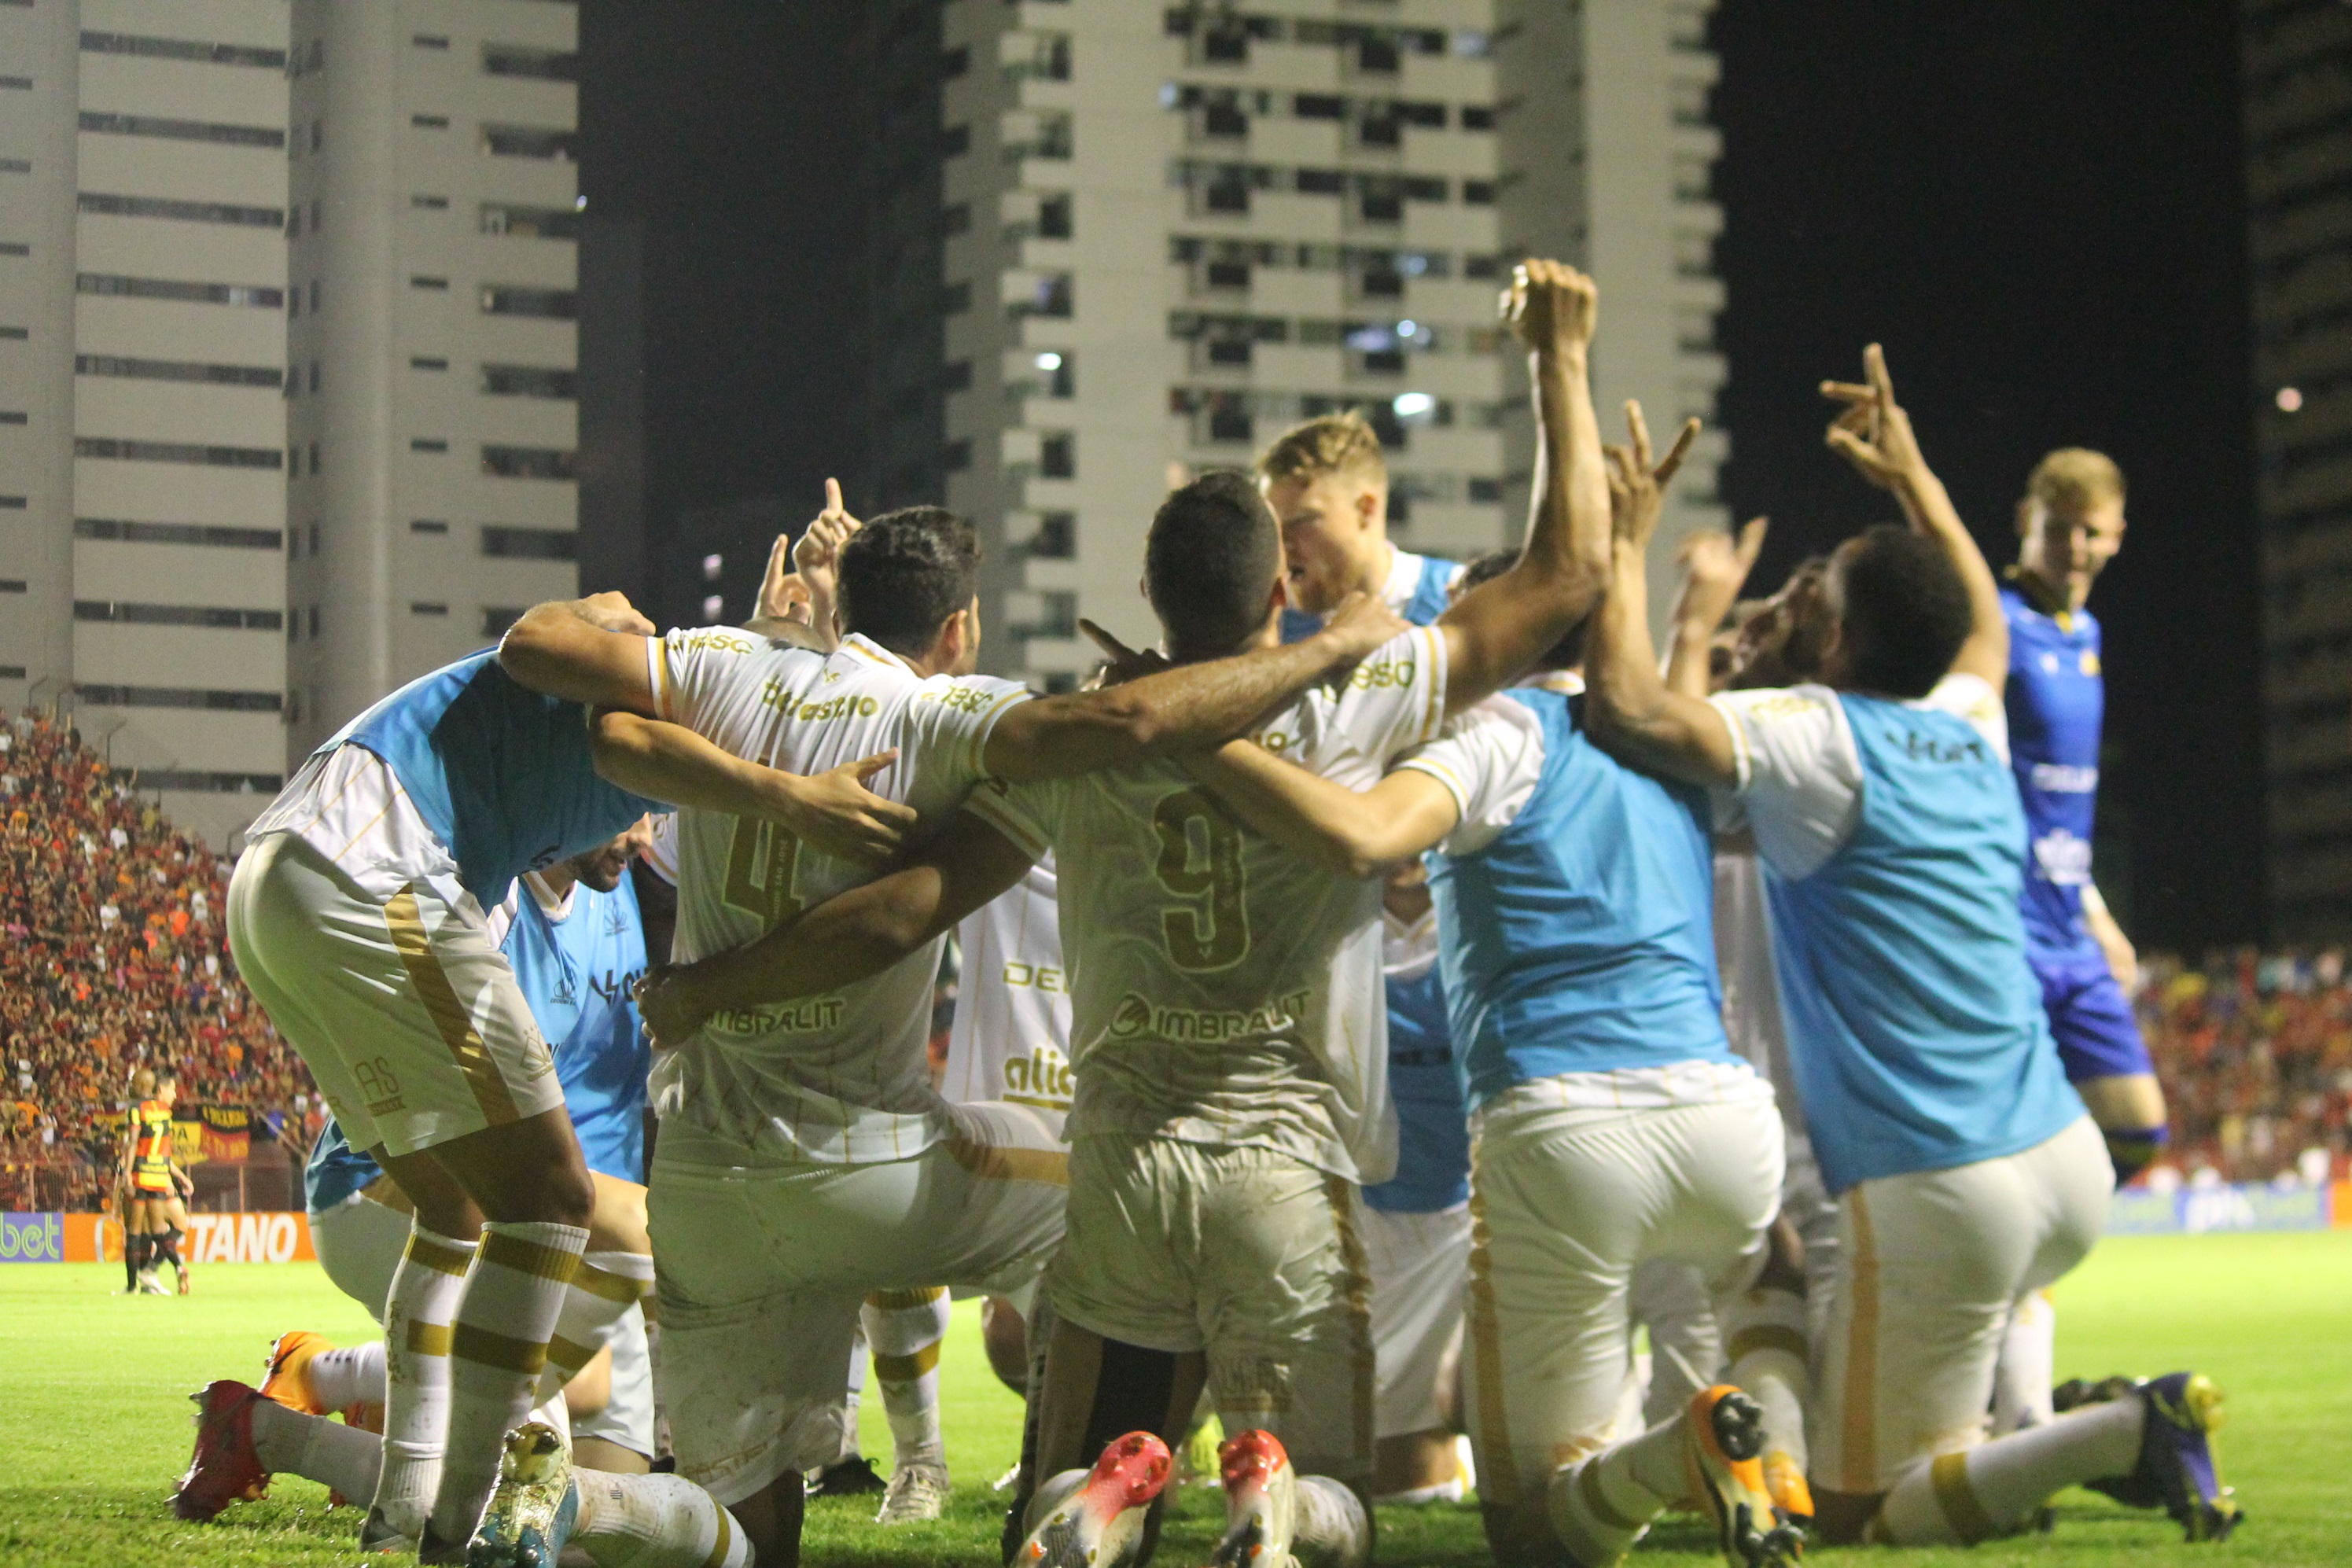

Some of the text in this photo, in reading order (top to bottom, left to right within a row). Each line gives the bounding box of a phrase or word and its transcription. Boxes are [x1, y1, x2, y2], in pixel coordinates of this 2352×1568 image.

[1154, 791, 1250, 973] 9
[1003, 961, 1071, 994] DE
[706, 1000, 844, 1035] MBRALIT
[152, 1122, 164, 1156] 7
[0, 1213, 60, 1259] bet
[181, 1214, 298, 1263] TANO
